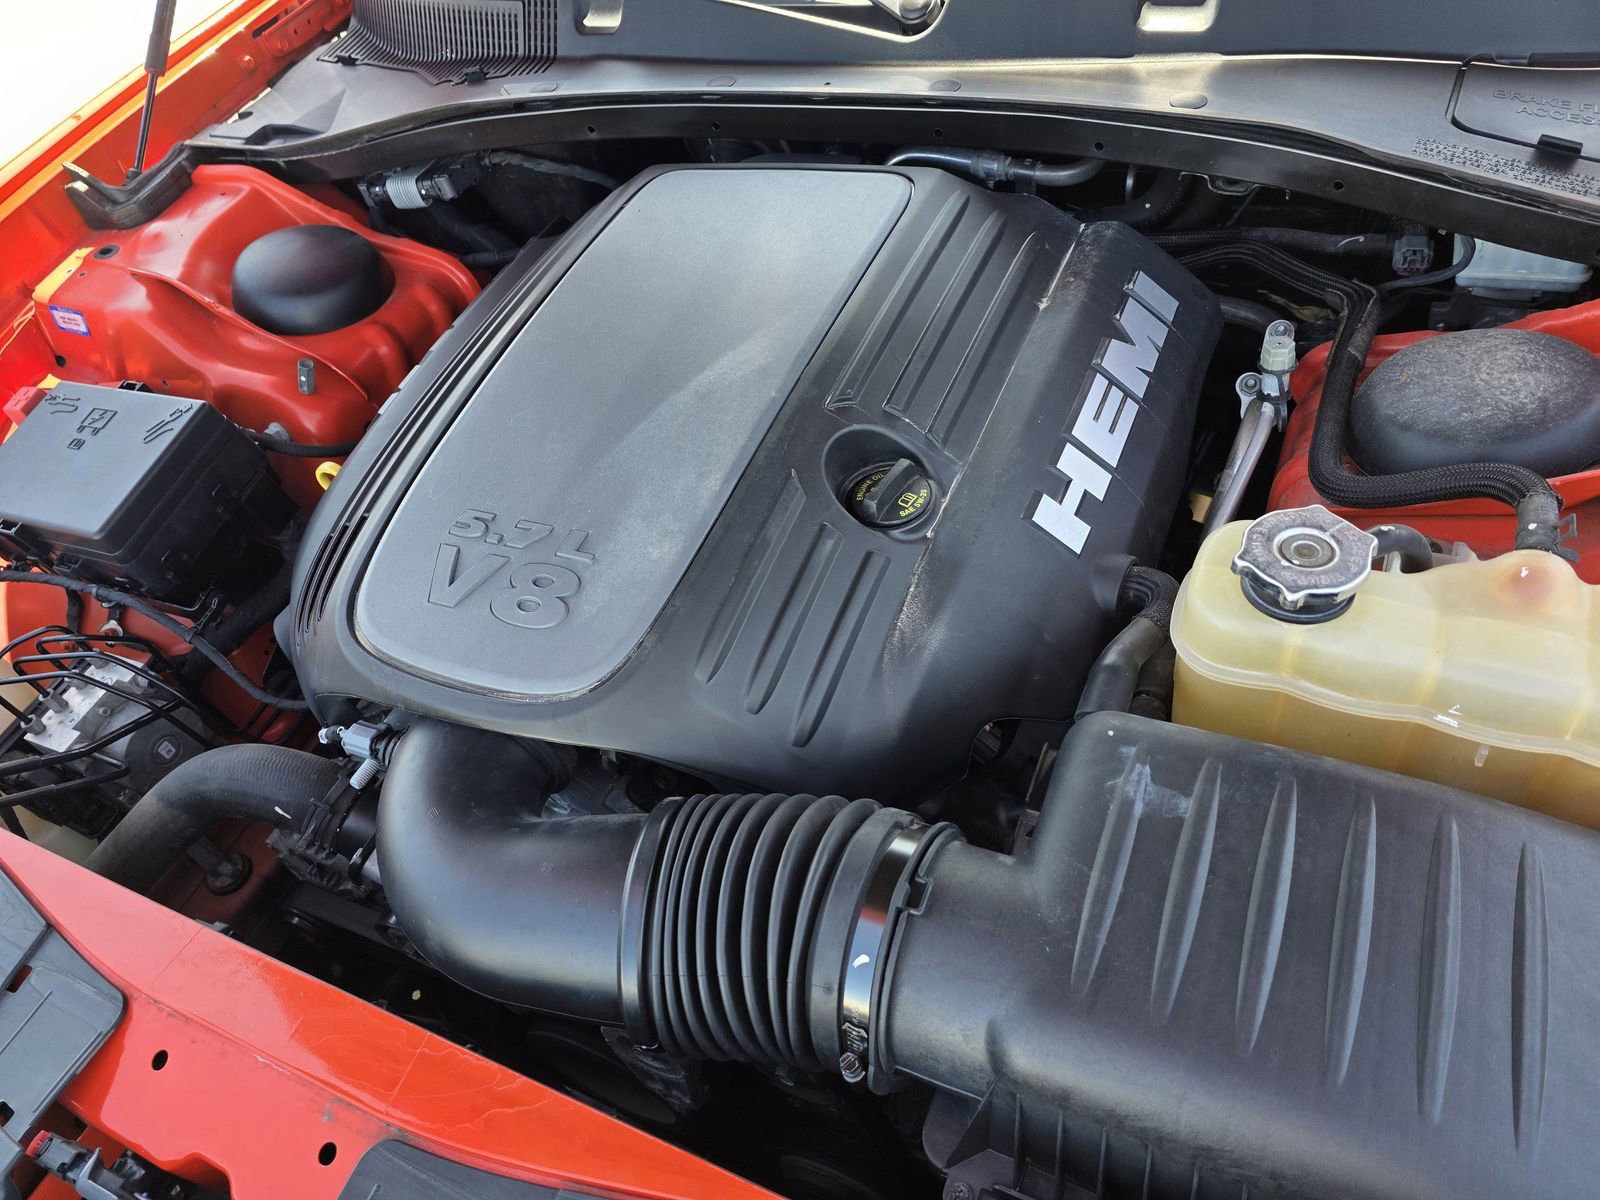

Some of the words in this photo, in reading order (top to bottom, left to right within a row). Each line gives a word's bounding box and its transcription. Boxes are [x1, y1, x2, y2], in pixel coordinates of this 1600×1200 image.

[1493, 86, 1572, 110] BRAKE
[1516, 104, 1600, 126] ACCES
[1029, 269, 1180, 557] HEMI
[856, 480, 873, 500] ENGINE
[899, 505, 916, 517] SAE
[448, 507, 596, 565] 5.7L
[427, 542, 583, 629] V8
